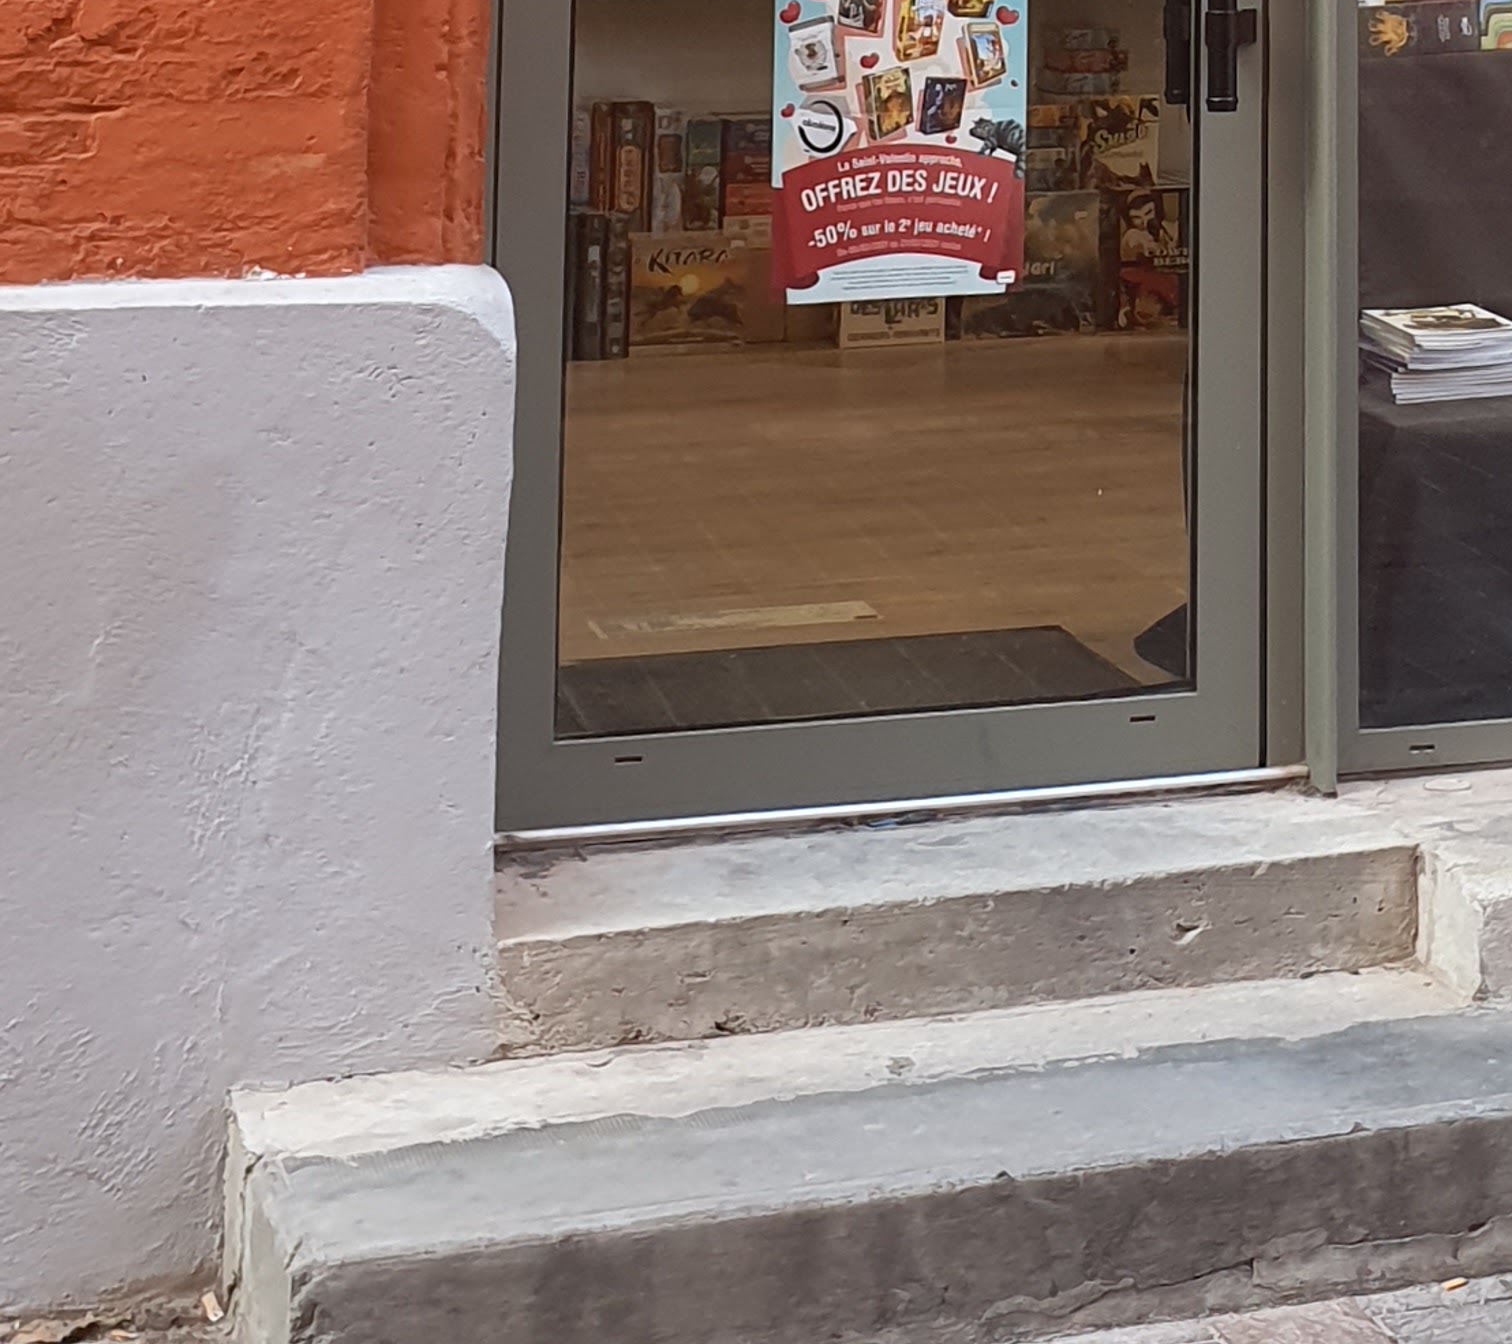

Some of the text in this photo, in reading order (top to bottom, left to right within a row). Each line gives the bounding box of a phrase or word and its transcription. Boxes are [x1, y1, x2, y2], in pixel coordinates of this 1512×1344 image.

[801, 172, 881, 212] OFFREZ
[887, 169, 927, 193] DES
[932, 171, 987, 200] JEUX
[987, 181, 998, 204] !
[808, 219, 858, 248] -50%
[913, 218, 932, 236] jeu
